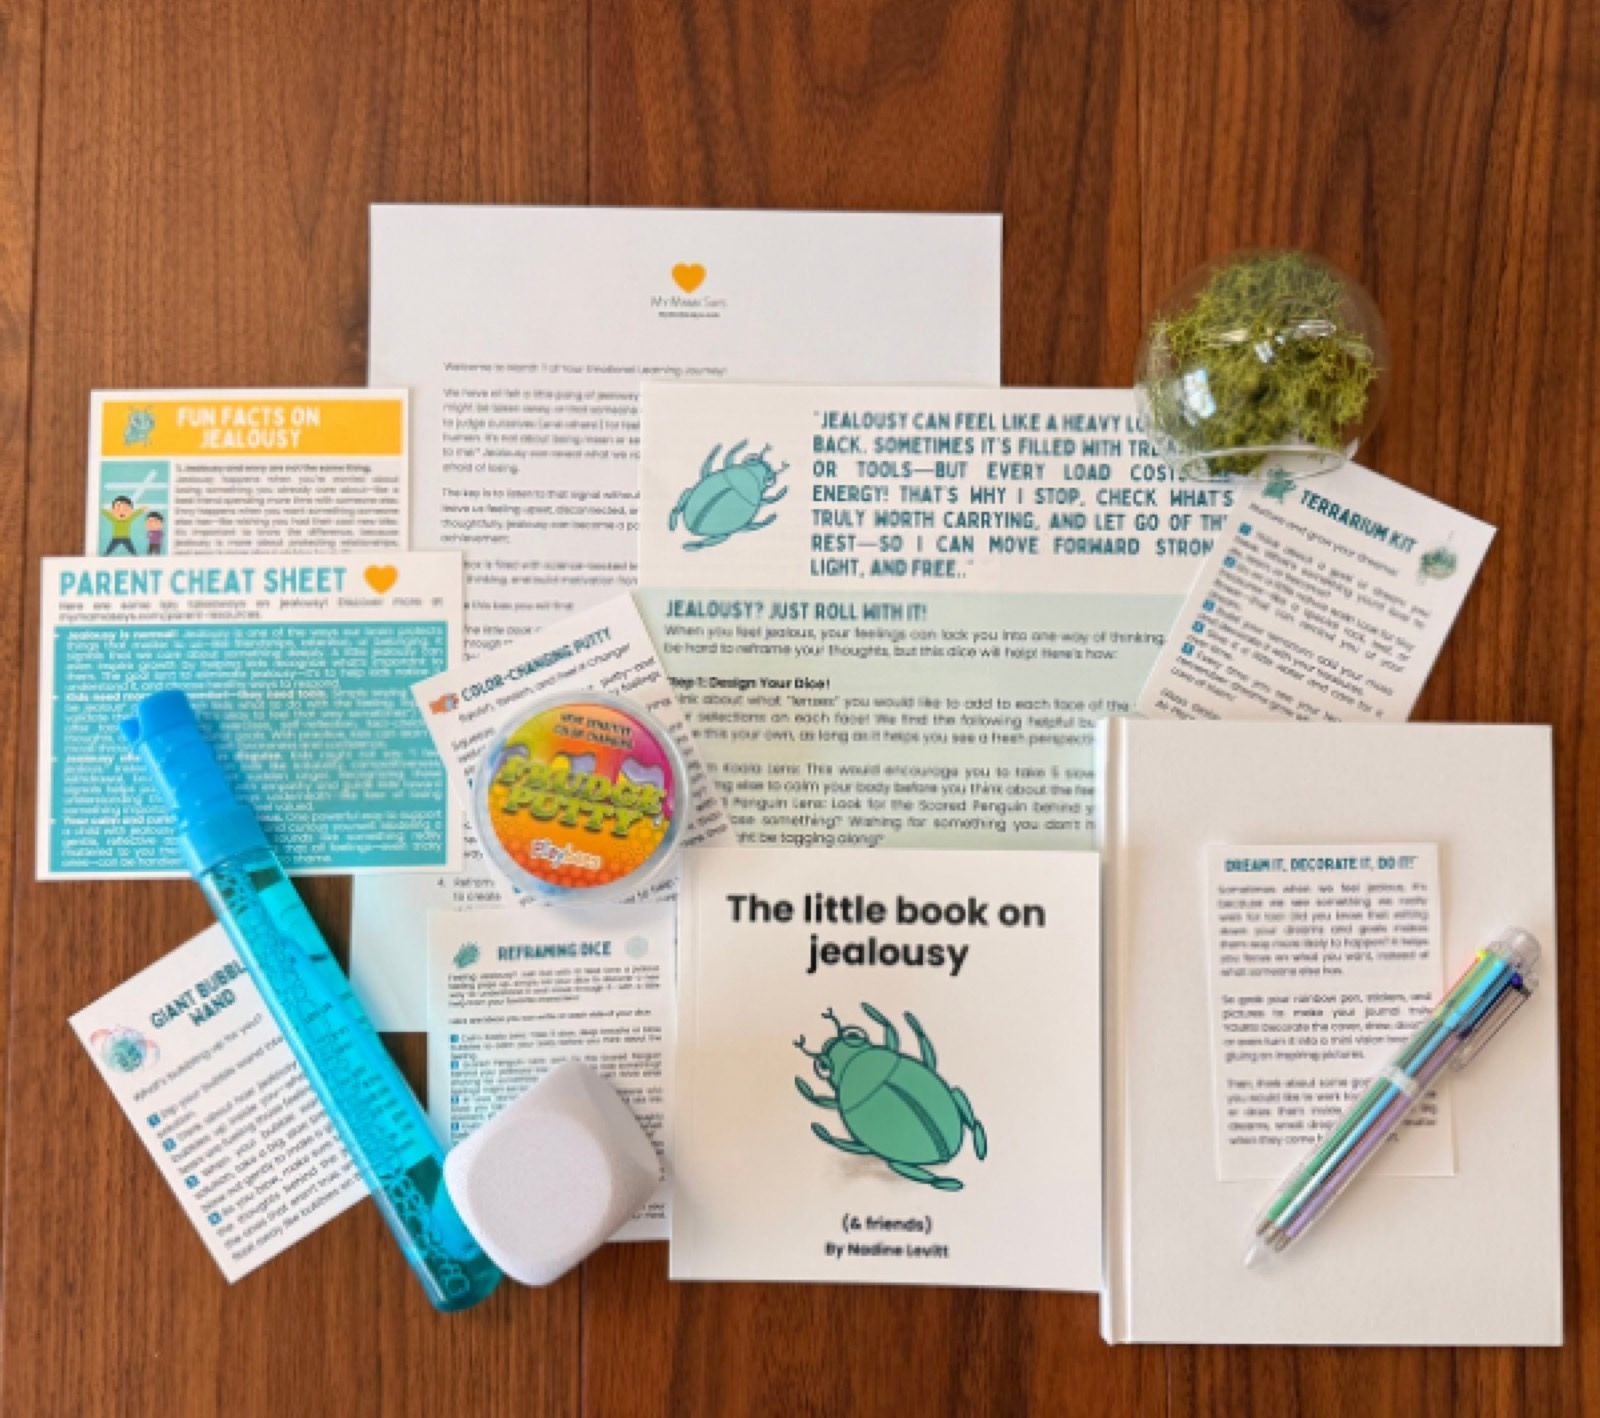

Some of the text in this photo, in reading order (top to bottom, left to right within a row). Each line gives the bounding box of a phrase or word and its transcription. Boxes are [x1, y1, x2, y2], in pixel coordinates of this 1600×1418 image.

[176, 406, 320, 429] FUN FACTS ON
[912, 412, 950, 430] CAN
[954, 412, 996, 432] FEEL
[1002, 412, 1040, 432] LIKE
[1045, 413, 1058, 432] A
[1062, 413, 1121, 432] HEAVY
[201, 427, 301, 449] JEALOUSY
[812, 434, 866, 454] BACK.
[874, 436, 974, 456] SOMETIMES
[981, 436, 1012, 456] IT'S
[1018, 436, 1076, 457] FILLED
[1081, 438, 1121, 457] WITH
[812, 460, 1185, 483] OR TOOLS—BUT EVERY LOAD COST
[812, 484, 888, 502] ENERGY!
[900, 484, 958, 504] THAT'S
[970, 485, 1006, 504] WHY
[1034, 487, 1085, 507] STOP,
[1095, 487, 1158, 507] CHECK
[1170, 488, 1234, 507] WHAT'S
[811, 508, 1228, 531] TRULY WORTH CARRYING, AND LET GO OF TH
[1300, 489, 1416, 552] TERRARIUM KIT
[810, 533, 903, 552] REST—SO
[935, 535, 974, 553] CAN
[988, 535, 1039, 555] MOVE
[1053, 535, 1140, 555] FORWARD
[1156, 537, 1214, 556] STRON
[810, 557, 864, 576] LIGHT,
[59, 566, 347, 596] PARENT CHEAT SHEET
[666, 599, 926, 621] JEALOUSY? JUST ROLL WITH IT!
[573, 627, 612, 655] PUTTY
[795, 676, 830, 689] Dice!
[503, 785, 643, 837] PUTTY
[727, 892, 1045, 927] The little book on
[806, 933, 969, 977] jealousy
[150, 960, 246, 1028] GIANT BUBBL
[188, 988, 236, 1026] WAND
[842, 1212, 932, 1235] (& friends)
[824, 1241, 948, 1259] By Nadine Levitt
